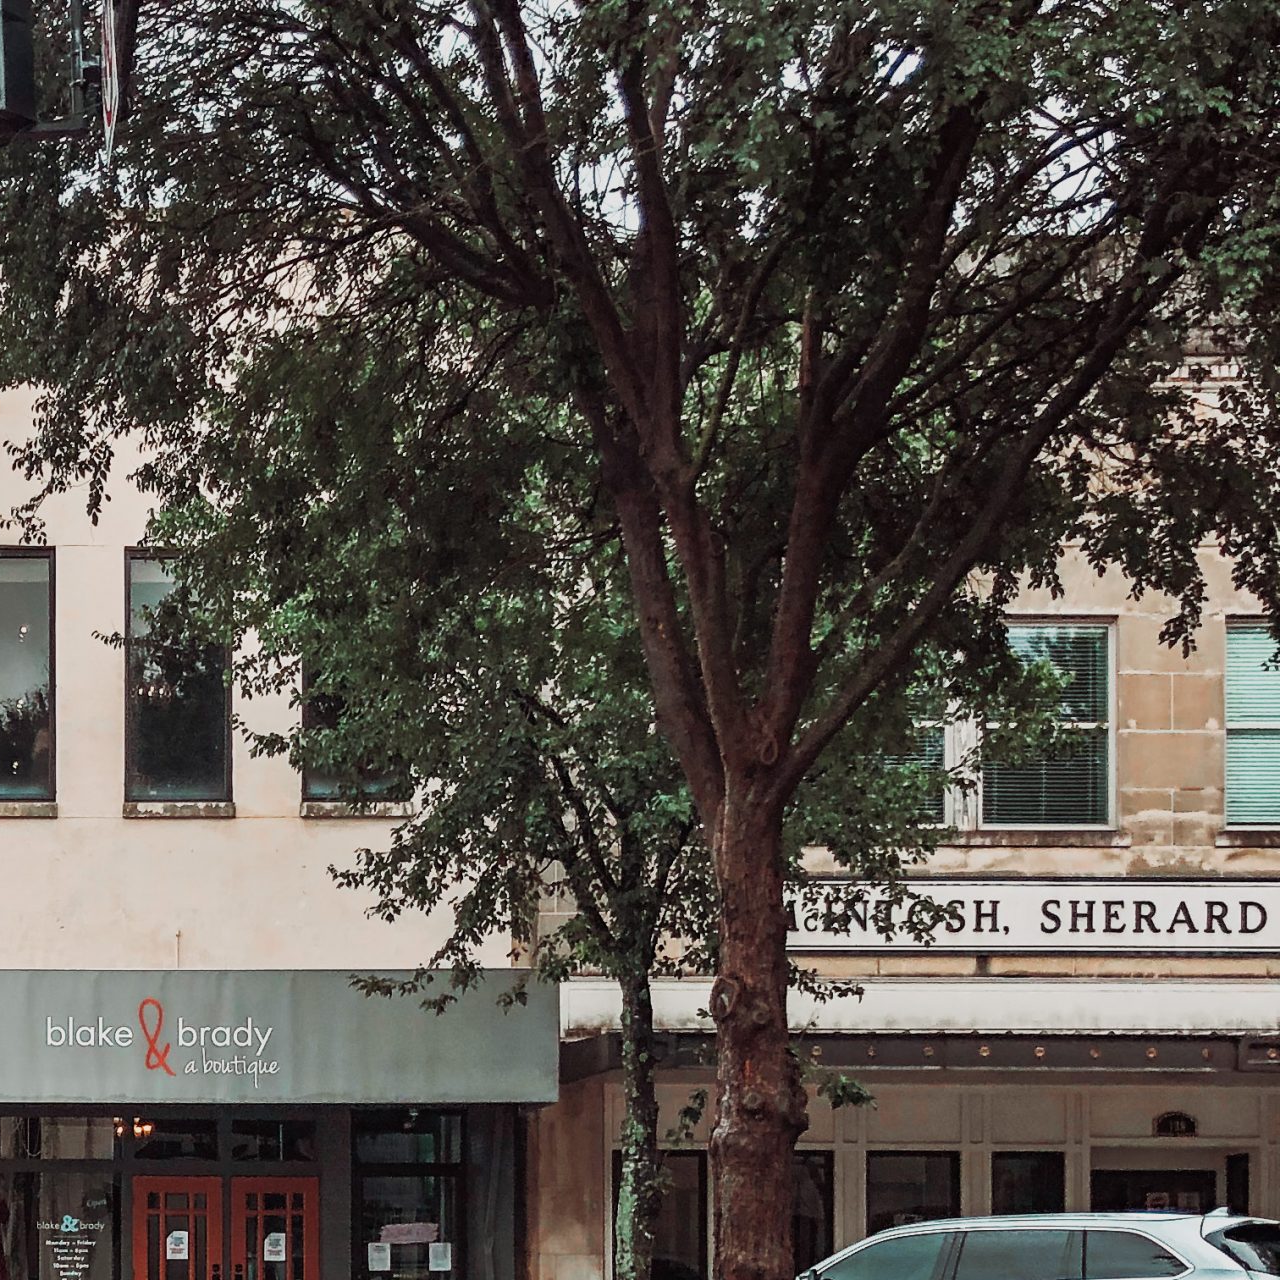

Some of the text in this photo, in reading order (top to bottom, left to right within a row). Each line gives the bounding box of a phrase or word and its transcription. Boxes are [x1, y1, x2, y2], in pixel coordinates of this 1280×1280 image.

[1040, 899, 1268, 934] SHERARD
[45, 995, 273, 1076] blake & brady
[184, 1048, 280, 1088] a boutique
[36, 1214, 105, 1232] blake & brady
[45, 1239, 70, 1247] Monday
[76, 1239, 96, 1247] Friday
